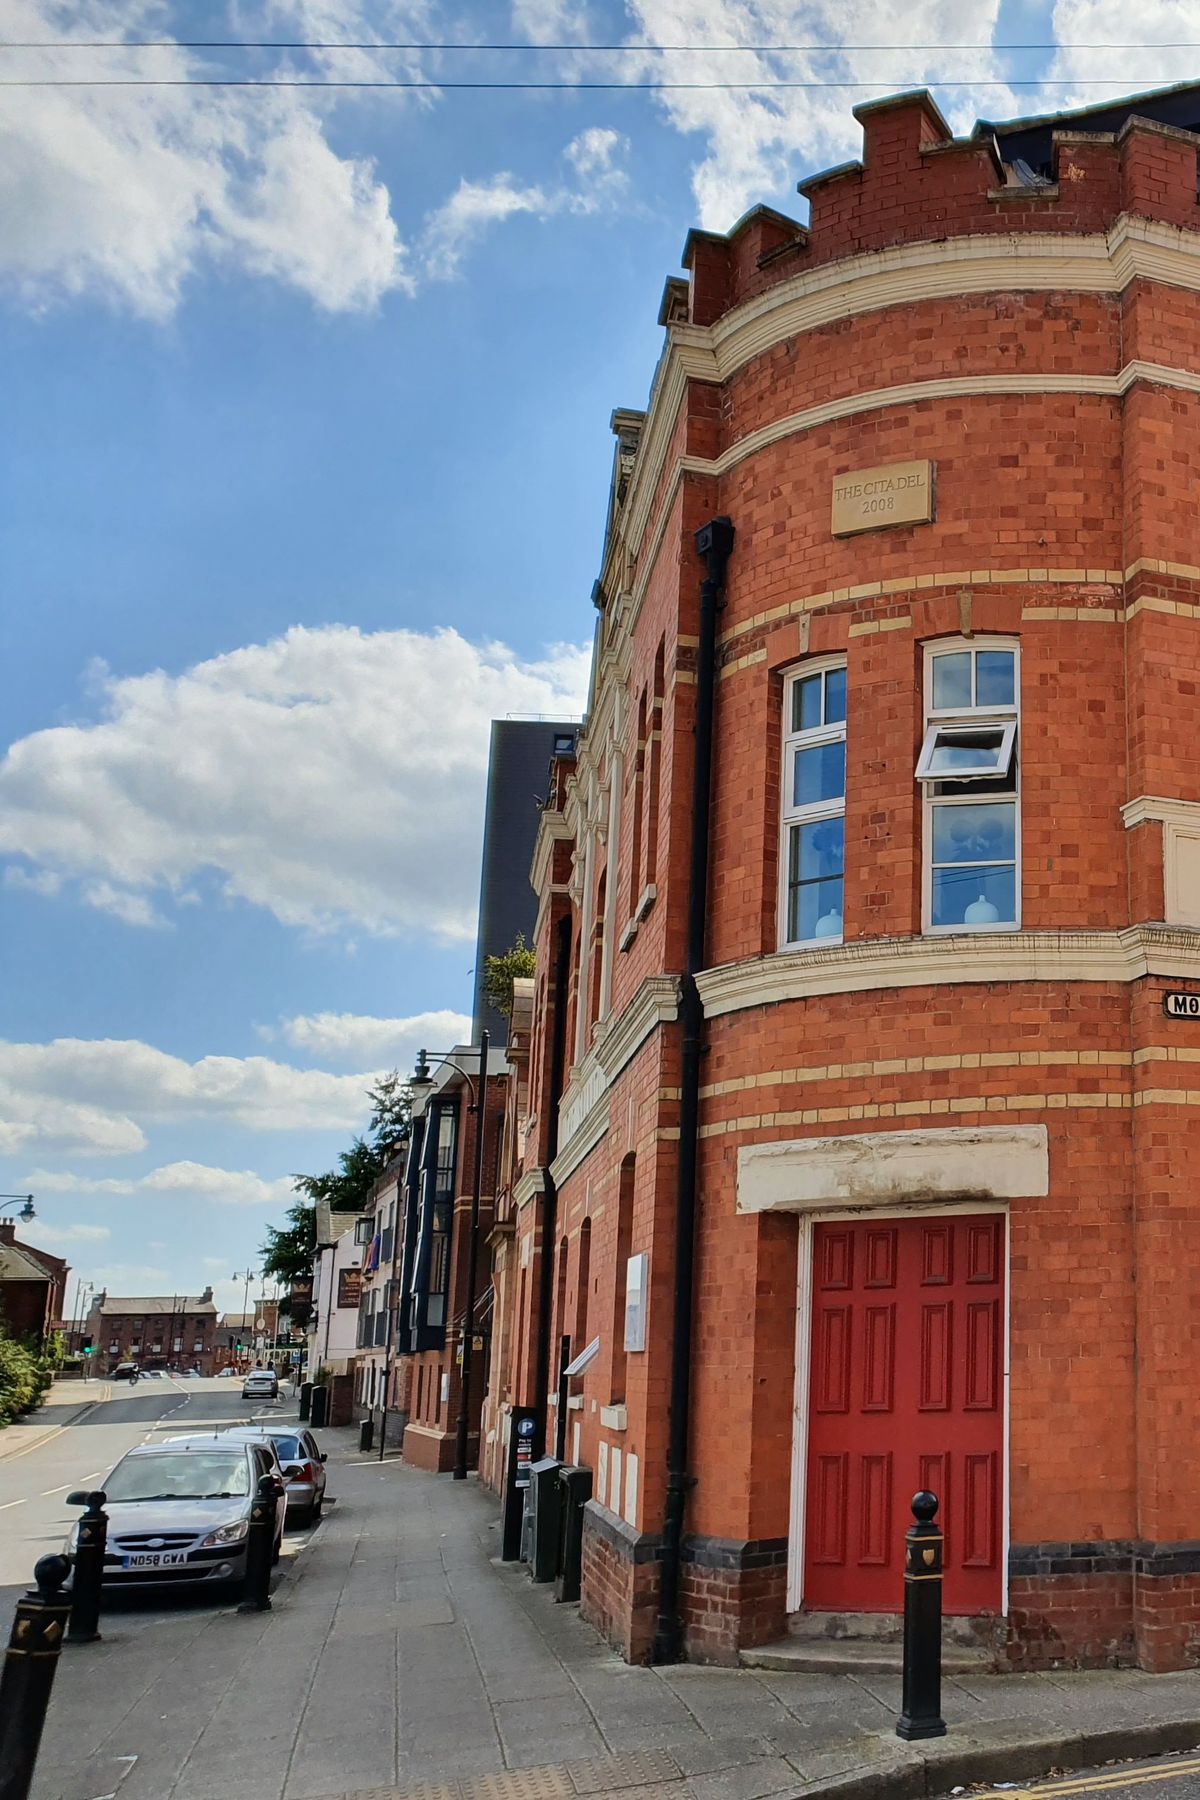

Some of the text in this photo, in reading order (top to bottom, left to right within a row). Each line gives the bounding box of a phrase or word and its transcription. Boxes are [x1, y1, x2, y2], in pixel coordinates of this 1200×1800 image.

[834, 474, 926, 501] THE CITADEL
[862, 497, 894, 514] 2008
[521, 1421, 533, 1434] P
[130, 1553, 185, 1566] ND58 GWA
